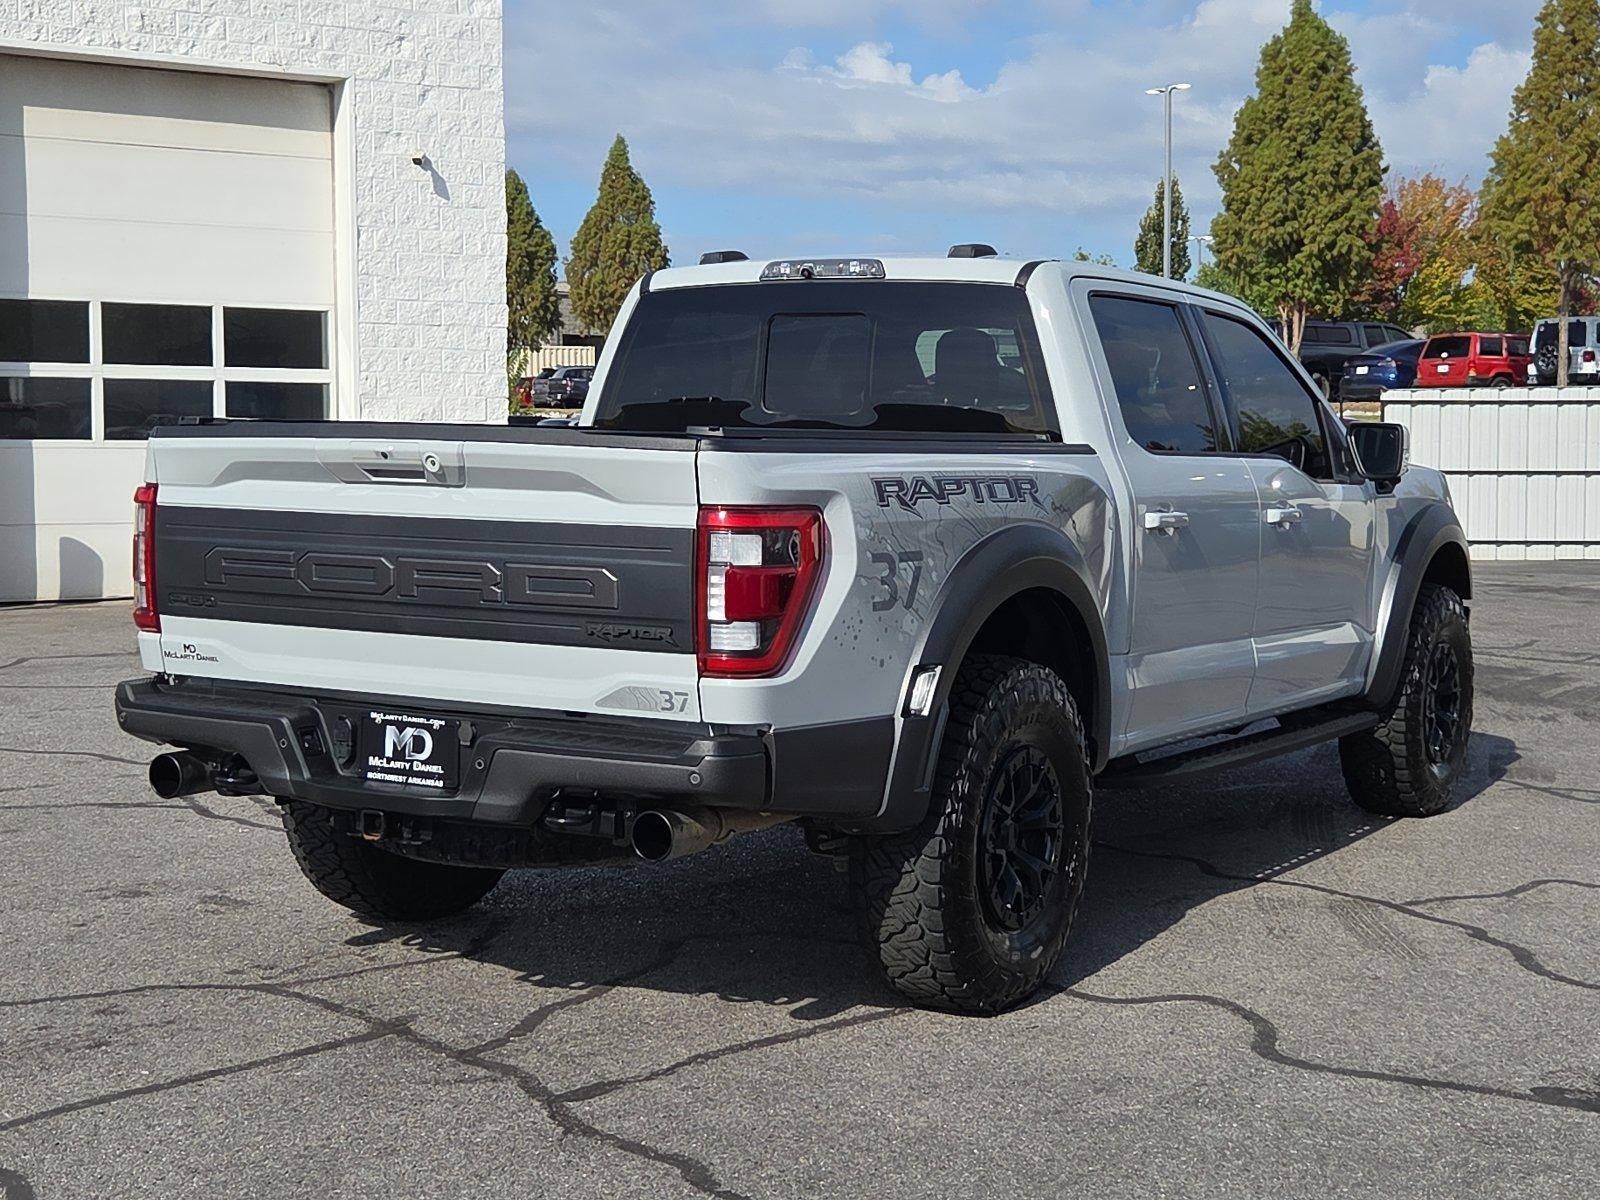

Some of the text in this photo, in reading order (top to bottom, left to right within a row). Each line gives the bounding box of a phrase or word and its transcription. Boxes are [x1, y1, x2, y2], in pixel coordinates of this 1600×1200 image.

[872, 476, 1049, 519] RAPTOR
[204, 545, 619, 609] FORD
[871, 550, 924, 612] 37
[183, 644, 196, 653] MD
[585, 621, 680, 647] RAPTOR
[660, 691, 689, 712] 37
[385, 725, 433, 760] MD
[367, 772, 443, 788] NORTHWEST ARKANSAS
